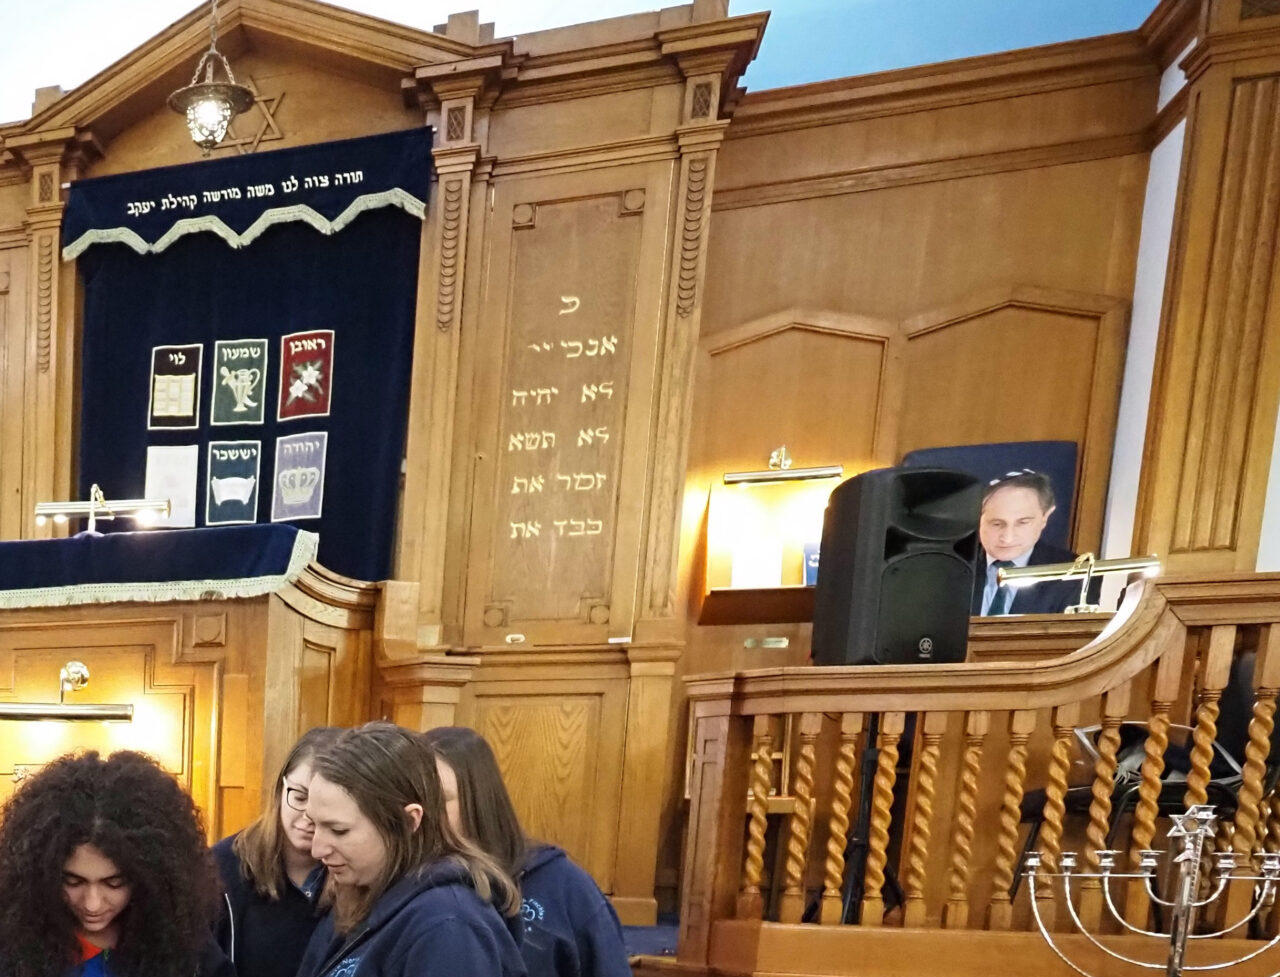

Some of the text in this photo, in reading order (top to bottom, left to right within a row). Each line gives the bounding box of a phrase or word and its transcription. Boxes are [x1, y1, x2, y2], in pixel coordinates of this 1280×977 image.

[127, 169, 363, 217] תורה צוה לנו משה מורשה קהילת יעקב
[222, 346, 261, 362] שמעון
[290, 338, 326, 355] ראובן
[560, 335, 618, 358] אנכי
[169, 351, 186, 365] לוי
[512, 381, 614, 407] לא יהיה
[283, 441, 320, 454] יהודה
[508, 426, 610, 452] לא תשא
[213, 448, 257, 461] יששכר
[511, 474, 545, 495] את
[510, 518, 603, 539] כבד את
